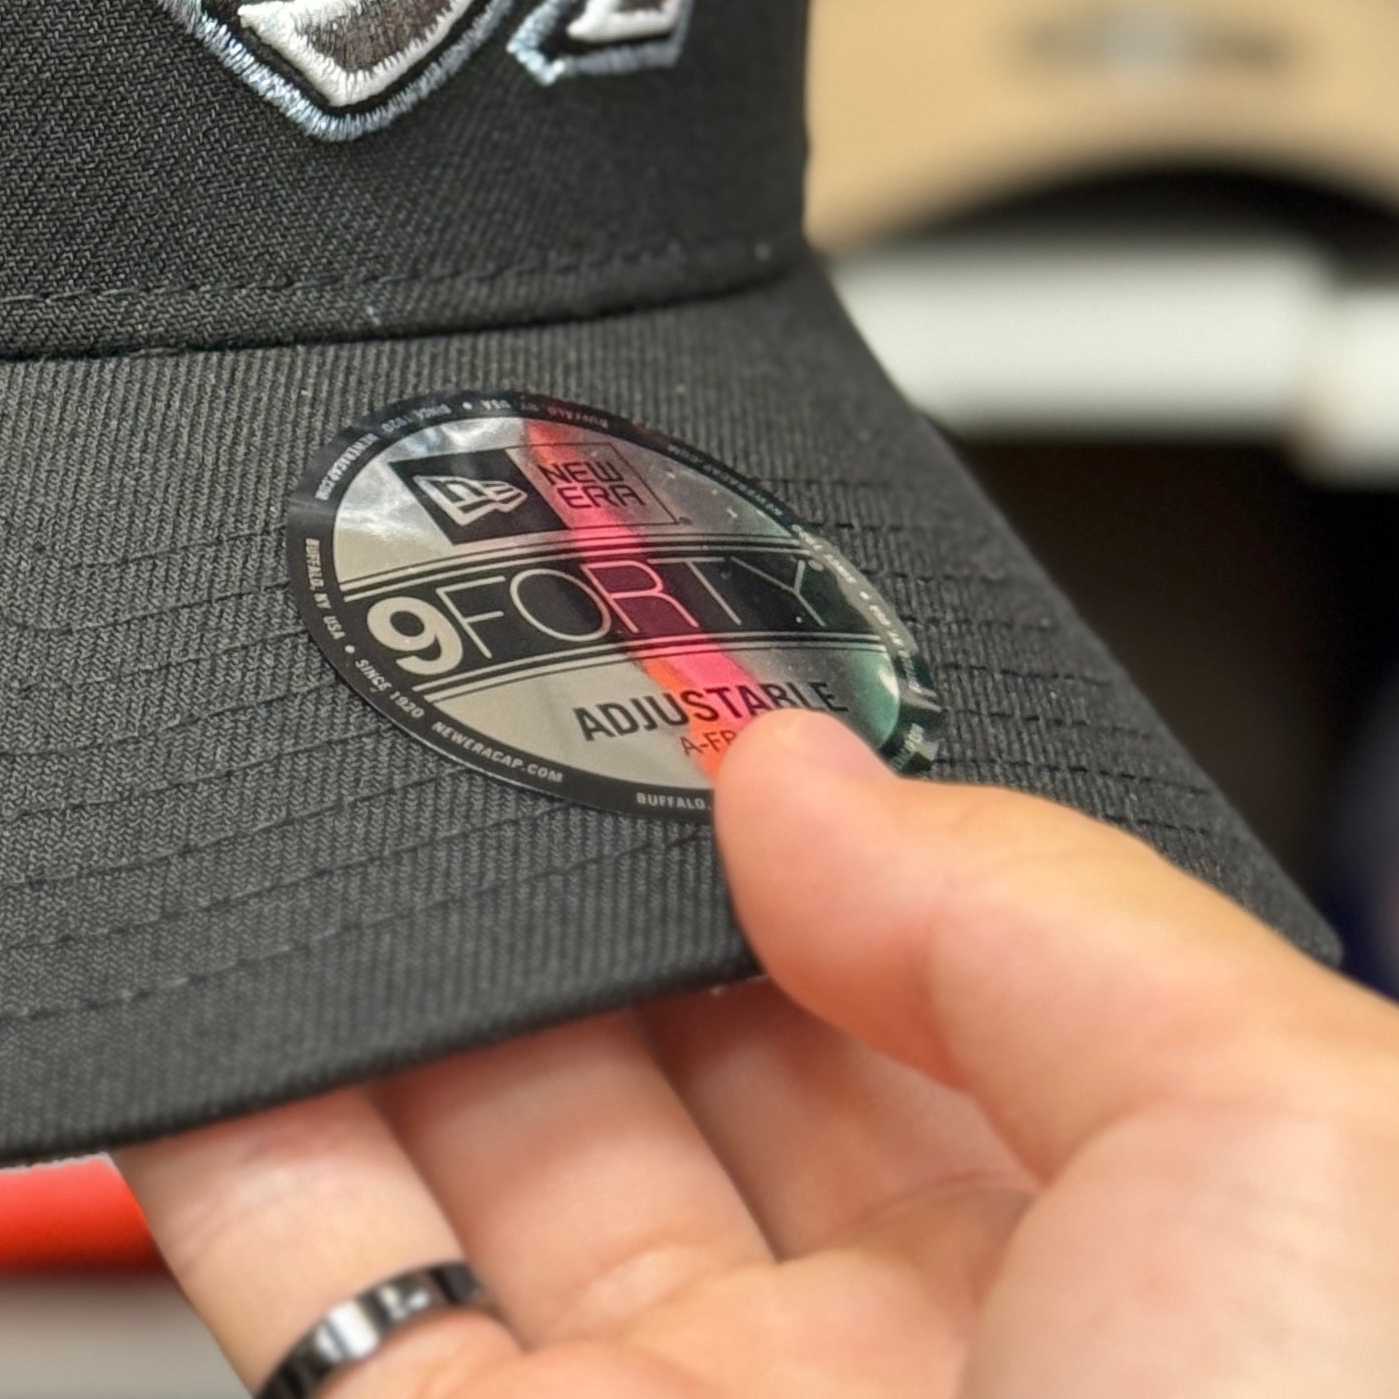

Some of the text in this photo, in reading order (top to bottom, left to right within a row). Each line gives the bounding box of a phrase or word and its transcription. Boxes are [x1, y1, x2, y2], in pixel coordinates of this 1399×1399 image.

[535, 461, 626, 485] NEW
[555, 483, 647, 510] ERA
[364, 554, 827, 676] 9FORTY
[323, 615, 346, 640] USA
[354, 657, 393, 693] SINCE
[389, 690, 425, 719] 1920
[431, 720, 564, 783] NEWERACAP.COM
